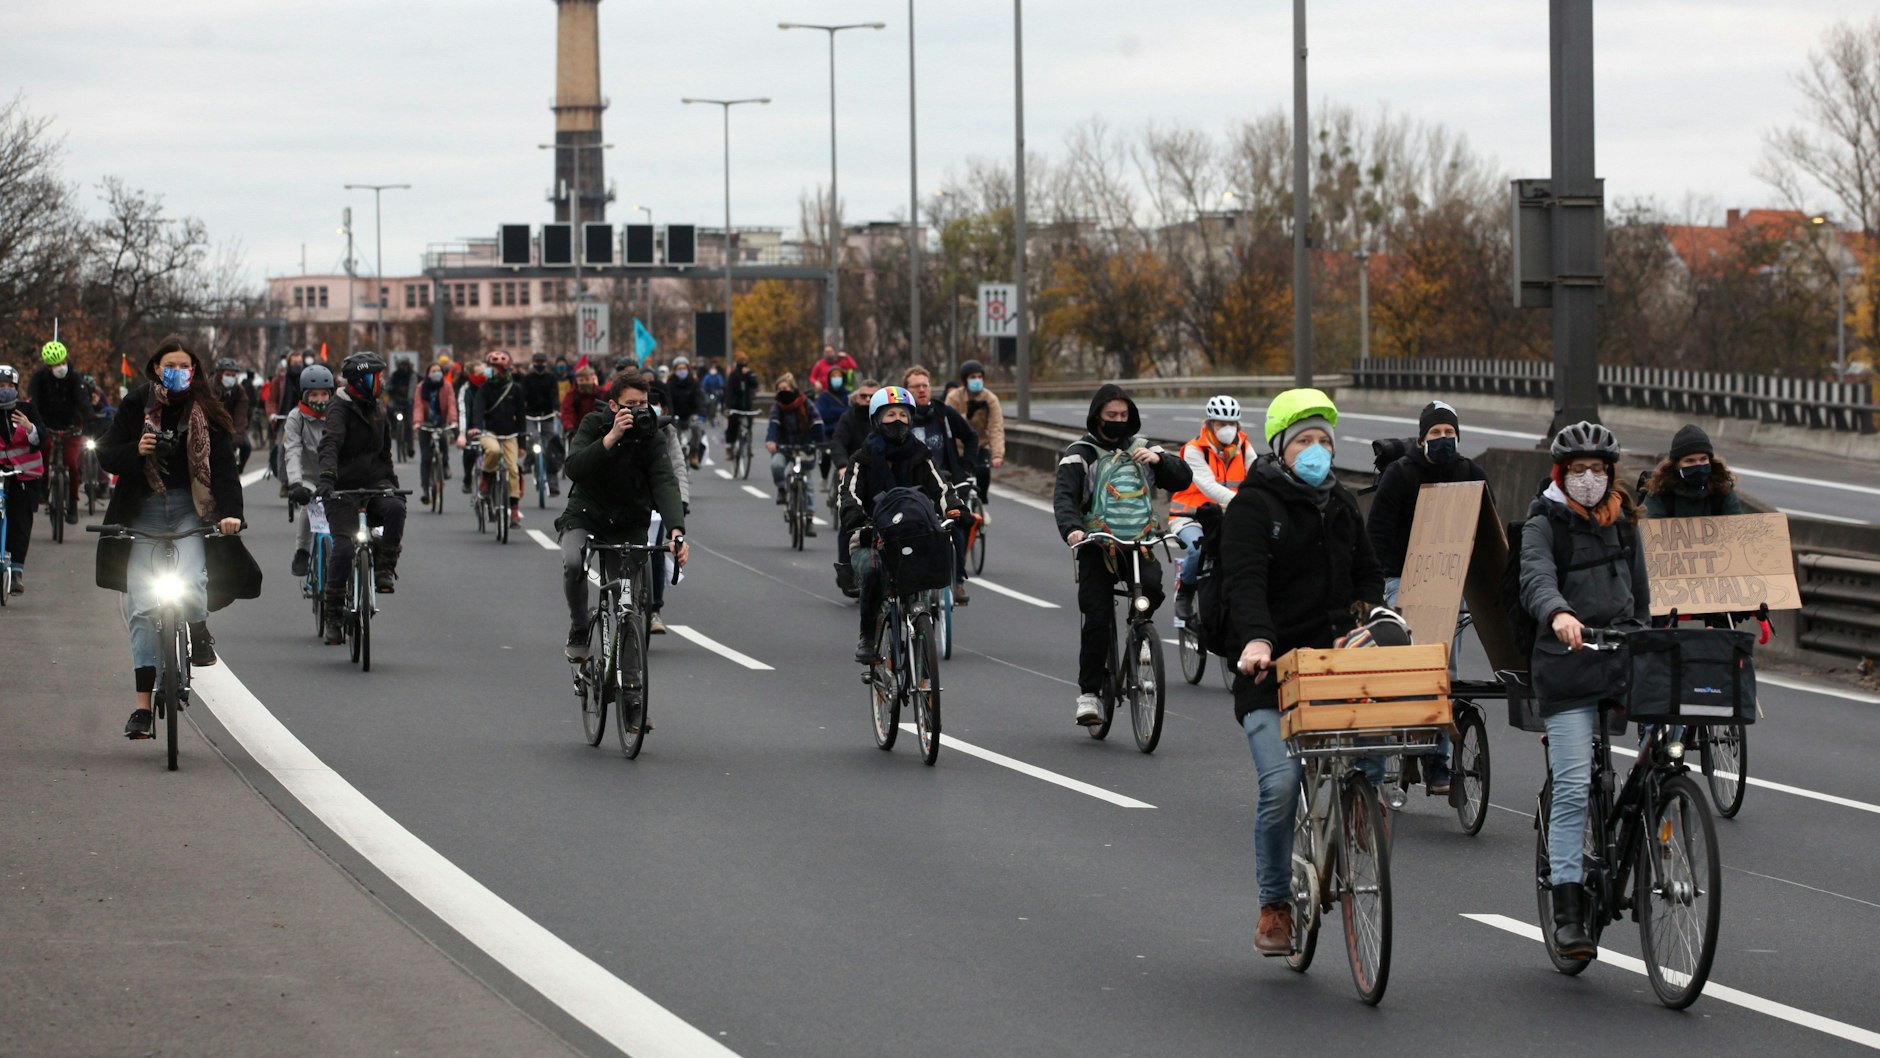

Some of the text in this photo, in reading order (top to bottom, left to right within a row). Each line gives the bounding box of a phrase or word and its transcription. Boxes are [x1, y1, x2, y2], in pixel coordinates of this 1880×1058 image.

[356, 362, 369, 371] city
[1641, 517, 1720, 552] WALD
[1649, 575, 1768, 607] ASPHALD
